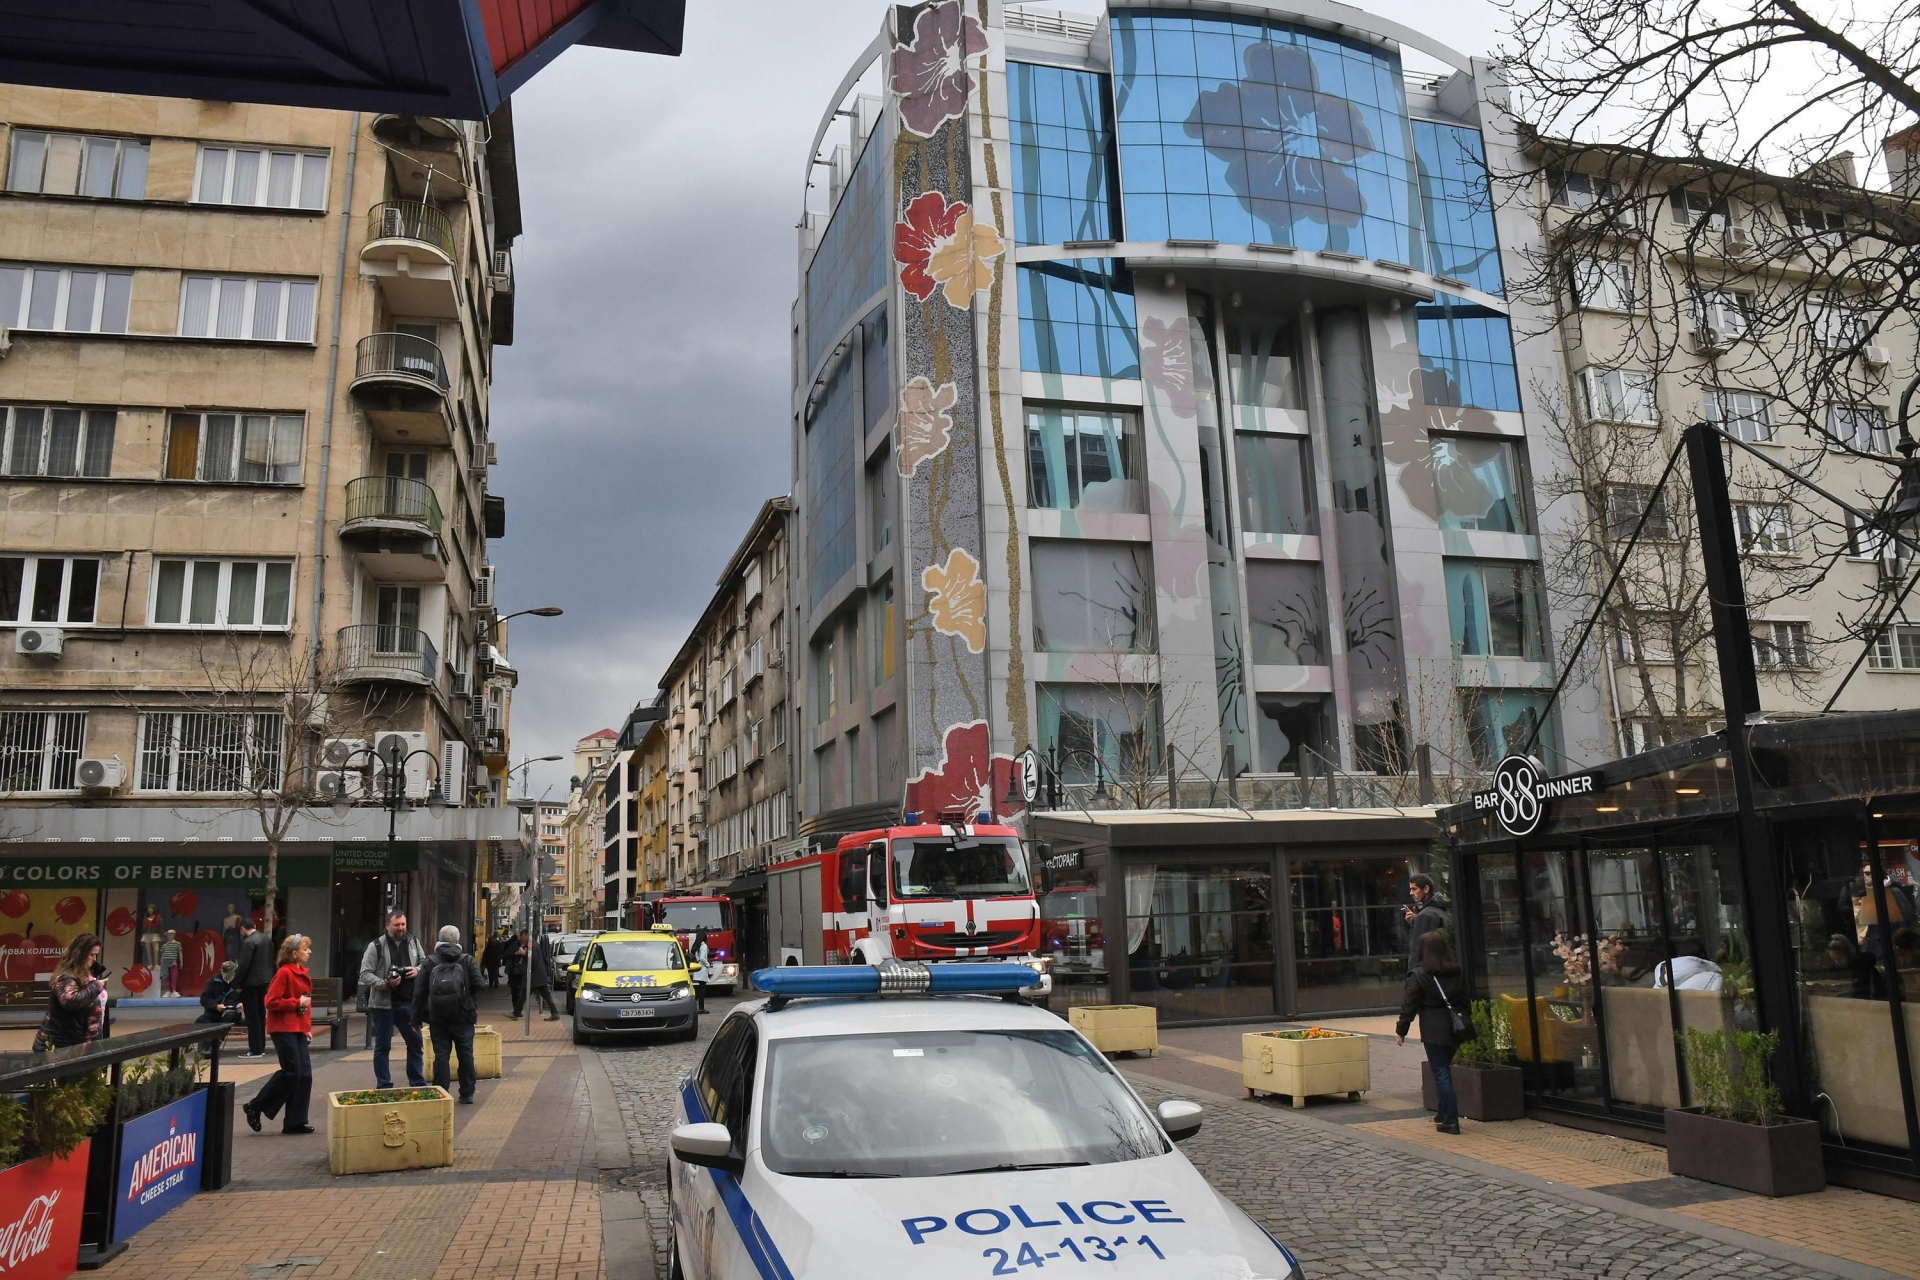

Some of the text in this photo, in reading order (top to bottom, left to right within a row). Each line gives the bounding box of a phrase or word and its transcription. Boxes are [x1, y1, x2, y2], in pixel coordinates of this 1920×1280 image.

[1474, 792, 1499, 809] BAR
[1536, 776, 1593, 800] DINNER
[335, 849, 362, 857] UNITED
[335, 858, 345, 866] OF
[13, 866, 100, 881] COLORS
[115, 865, 142, 879] OF
[2, 947, 68, 956] НОВА КОЛЕКЦИ
[128, 1132, 196, 1201] AMERICAN
[140, 1169, 184, 1205] CHEESE STEAK
[901, 1199, 1186, 1245] POLICE
